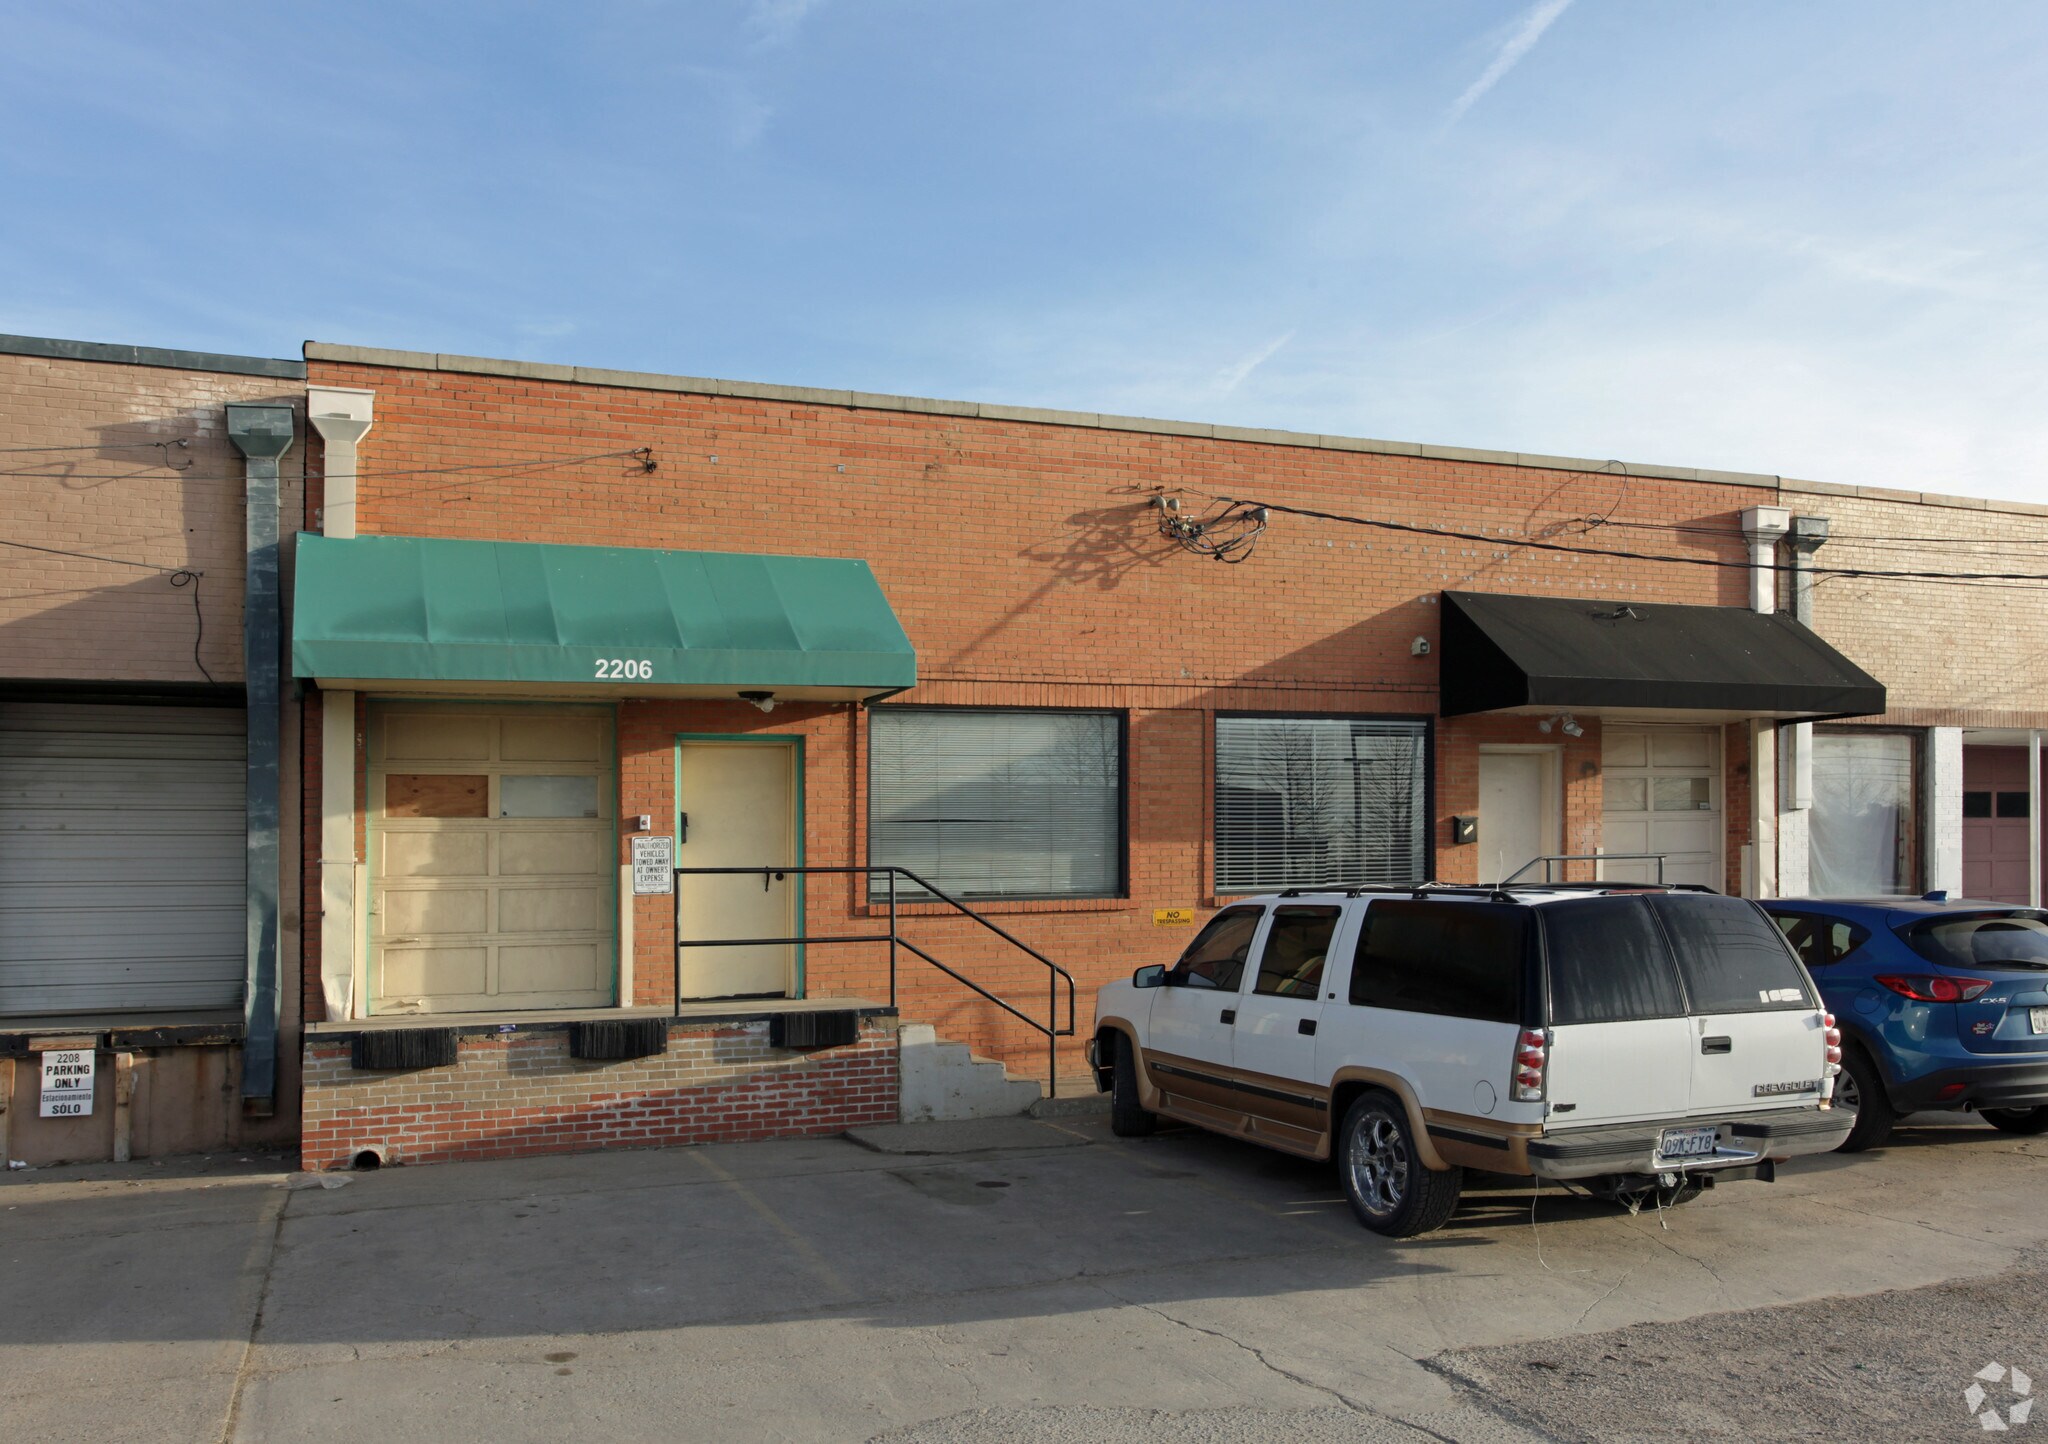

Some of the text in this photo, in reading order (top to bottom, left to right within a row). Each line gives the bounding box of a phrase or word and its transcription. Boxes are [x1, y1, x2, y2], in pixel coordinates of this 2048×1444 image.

[595, 658, 653, 680] 2206
[635, 842, 670, 850] UNAUTHORIZED
[639, 850, 665, 858] VEHICLES
[636, 858, 669, 866] TOWED AWAY
[636, 866, 643, 874] AT
[640, 874, 664, 882] EXPENSE
[57, 1053, 80, 1064] 2208
[46, 1064, 90, 1076] PARKING
[54, 1077, 81, 1089] ONLY
[1755, 1079, 1816, 1093] CHEVROLET
[42, 1092, 92, 1102] Estacionamiento
[52, 1102, 81, 1115] SÓLO
